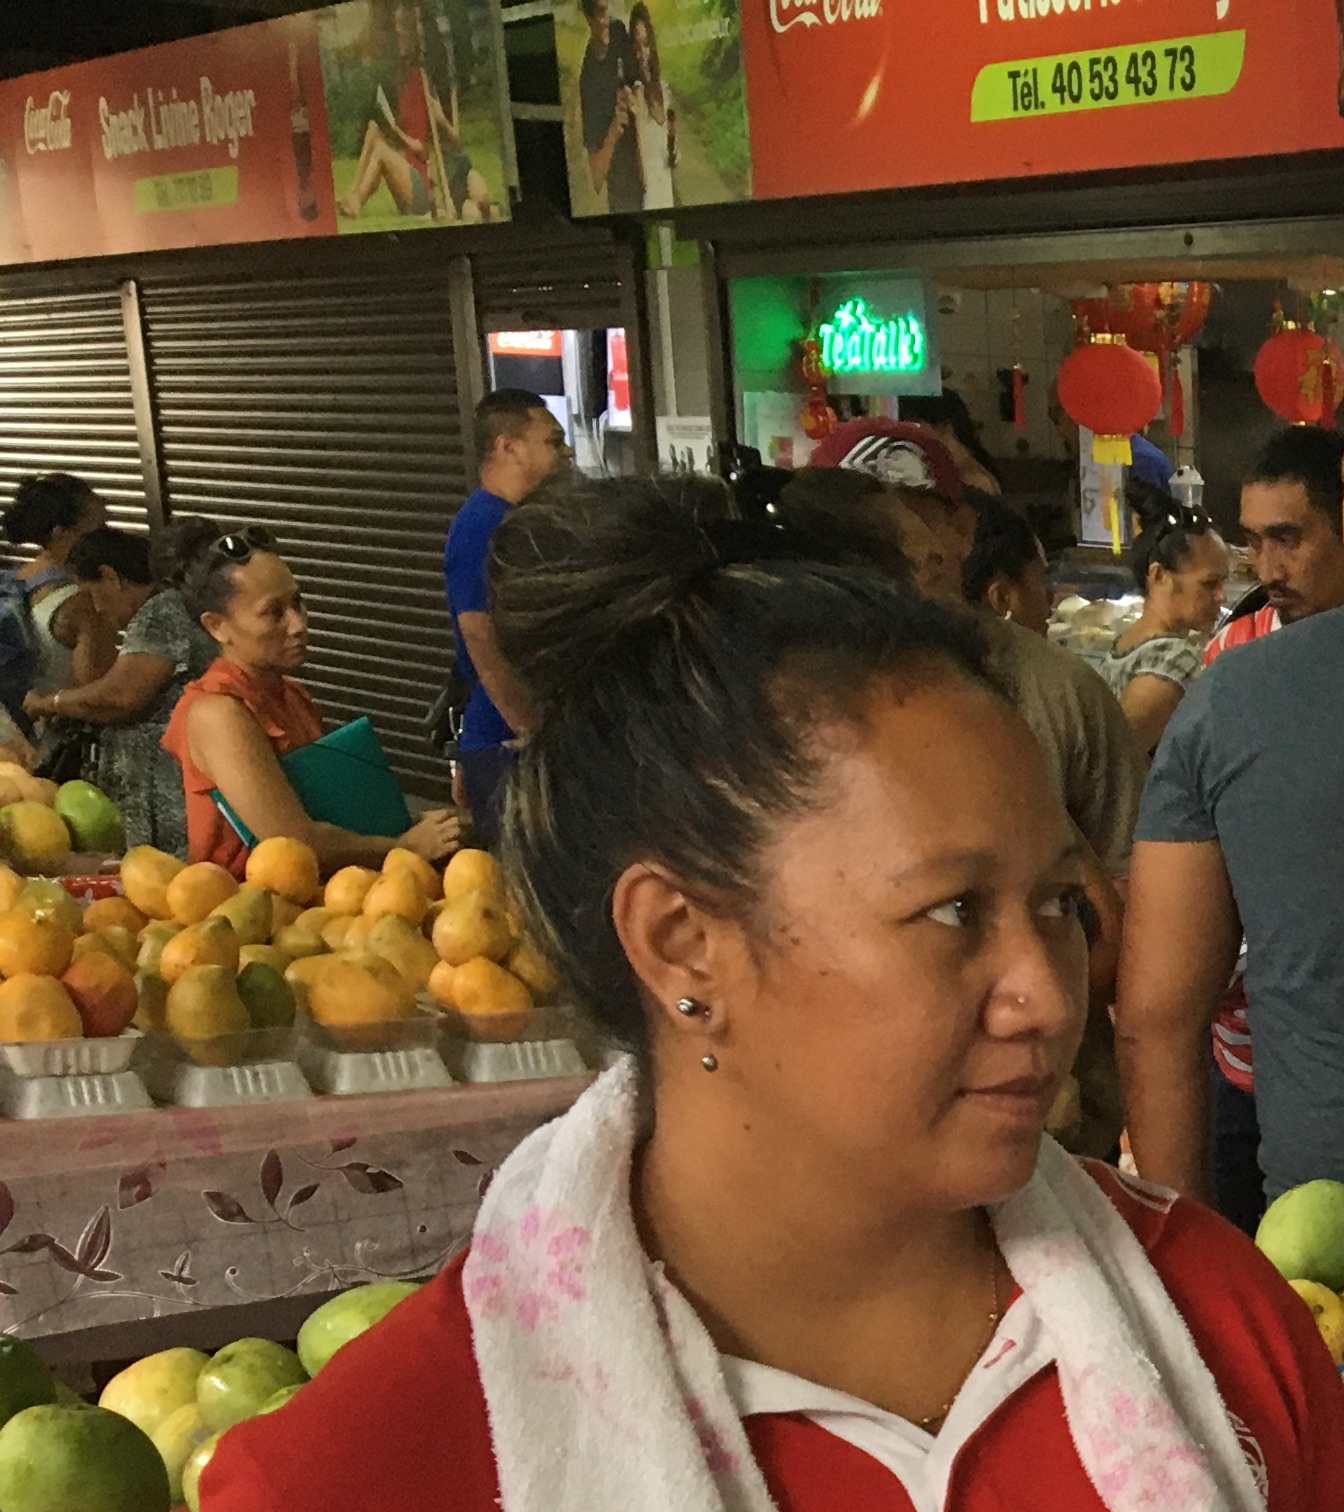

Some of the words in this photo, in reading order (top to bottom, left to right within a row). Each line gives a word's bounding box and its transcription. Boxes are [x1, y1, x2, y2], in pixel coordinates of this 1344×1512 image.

[1007, 67, 1046, 112] Tél.
[1050, 60, 1082, 105] 40
[1088, 55, 1119, 102] 53
[1125, 50, 1158, 97] 43
[1164, 45, 1196, 92] 73
